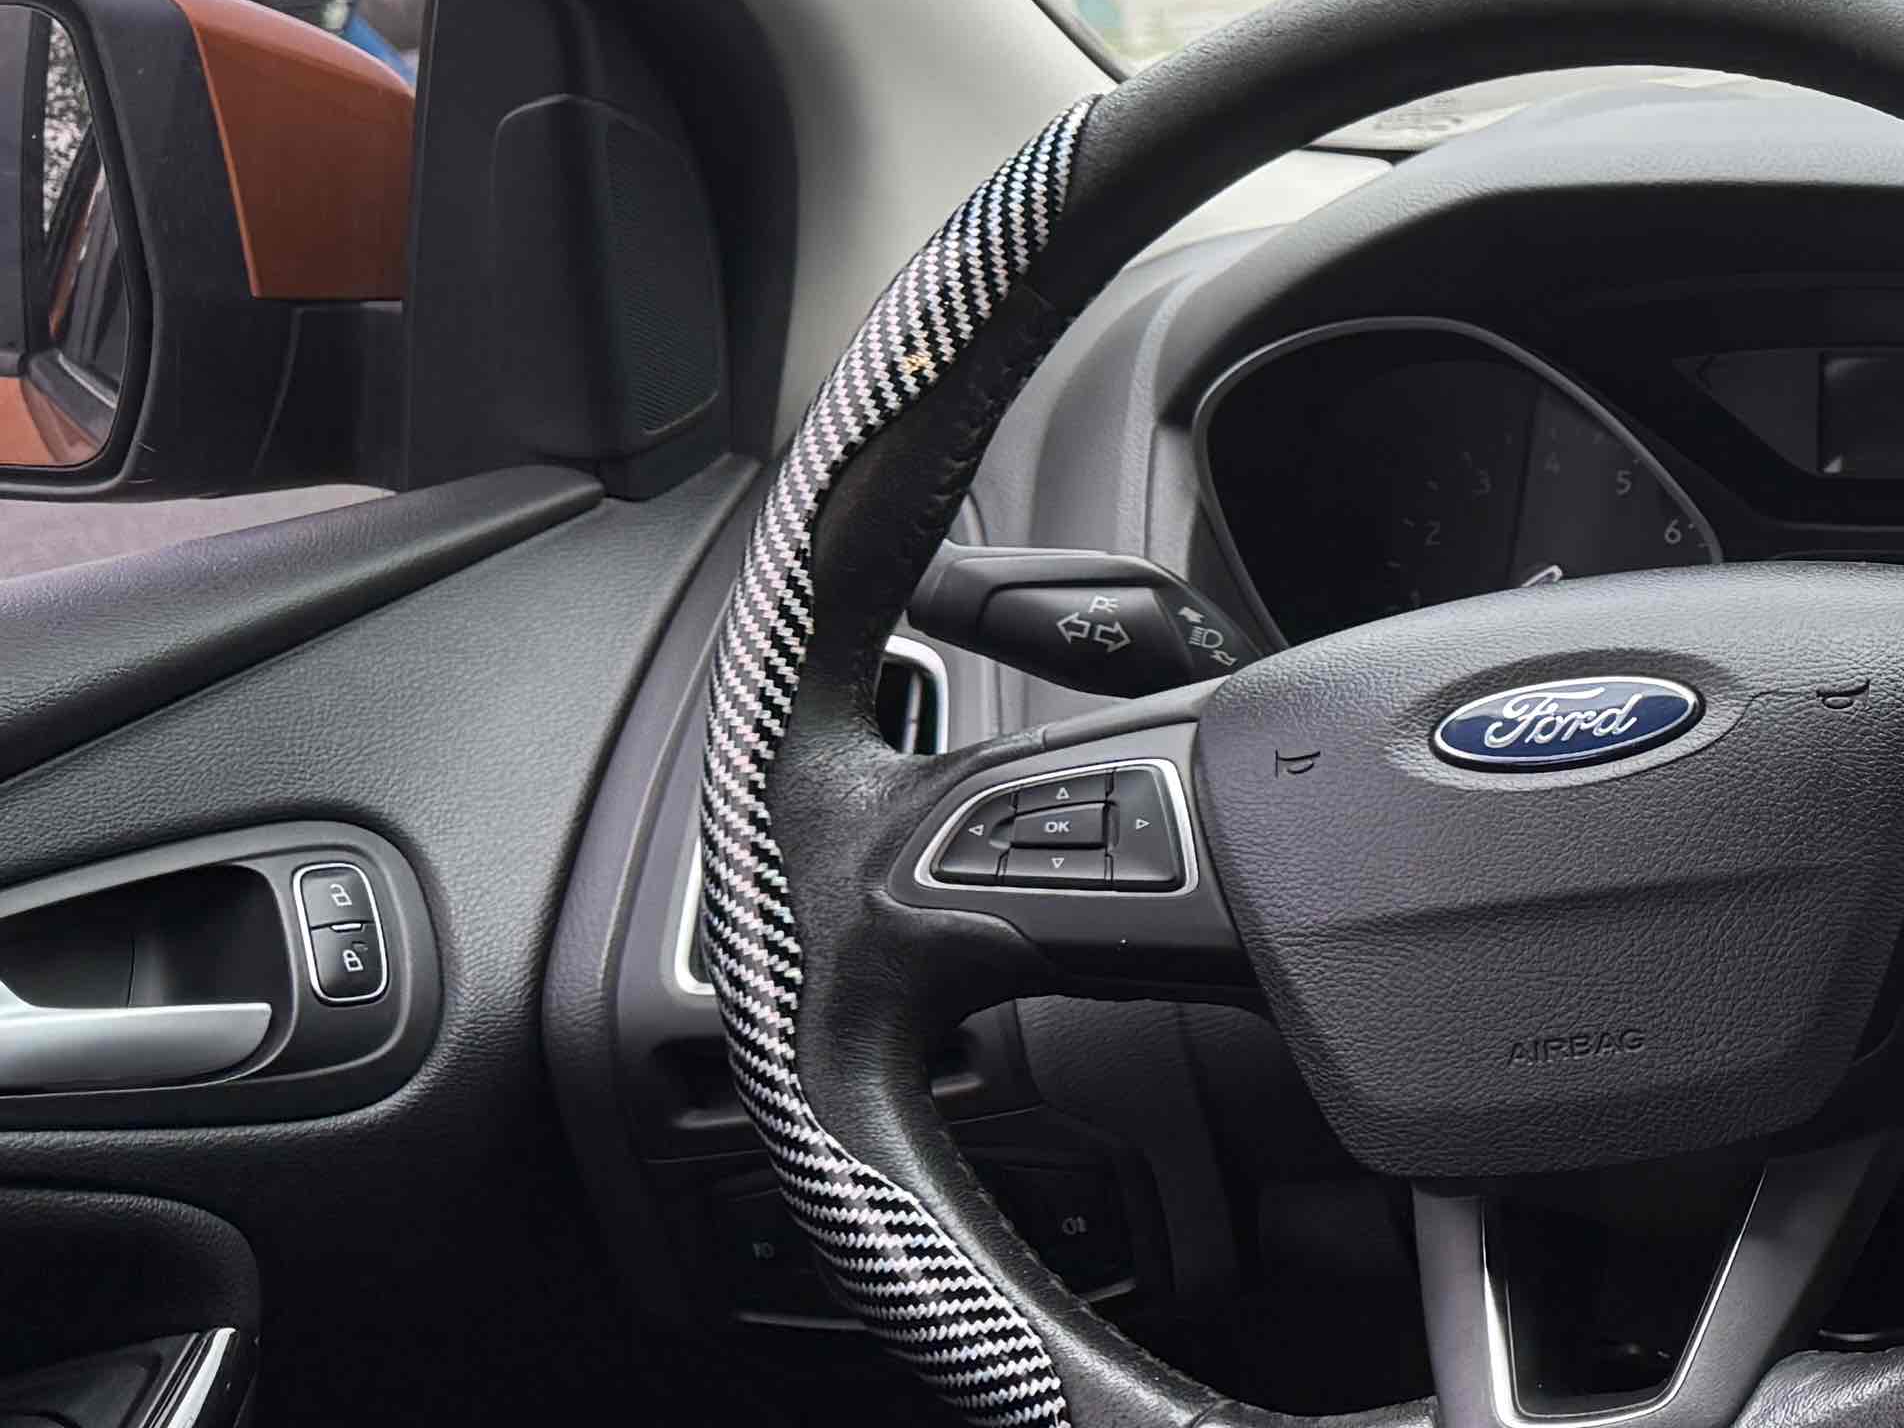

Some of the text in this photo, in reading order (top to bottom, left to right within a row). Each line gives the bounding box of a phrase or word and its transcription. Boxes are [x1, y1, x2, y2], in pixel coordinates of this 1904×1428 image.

[1615, 470, 1633, 496] 5
[1663, 519, 1682, 545] 6
[1484, 686, 1643, 748] Ford
[1044, 821, 1072, 834] OK
[1506, 1028, 1646, 1066] AIRBAG
